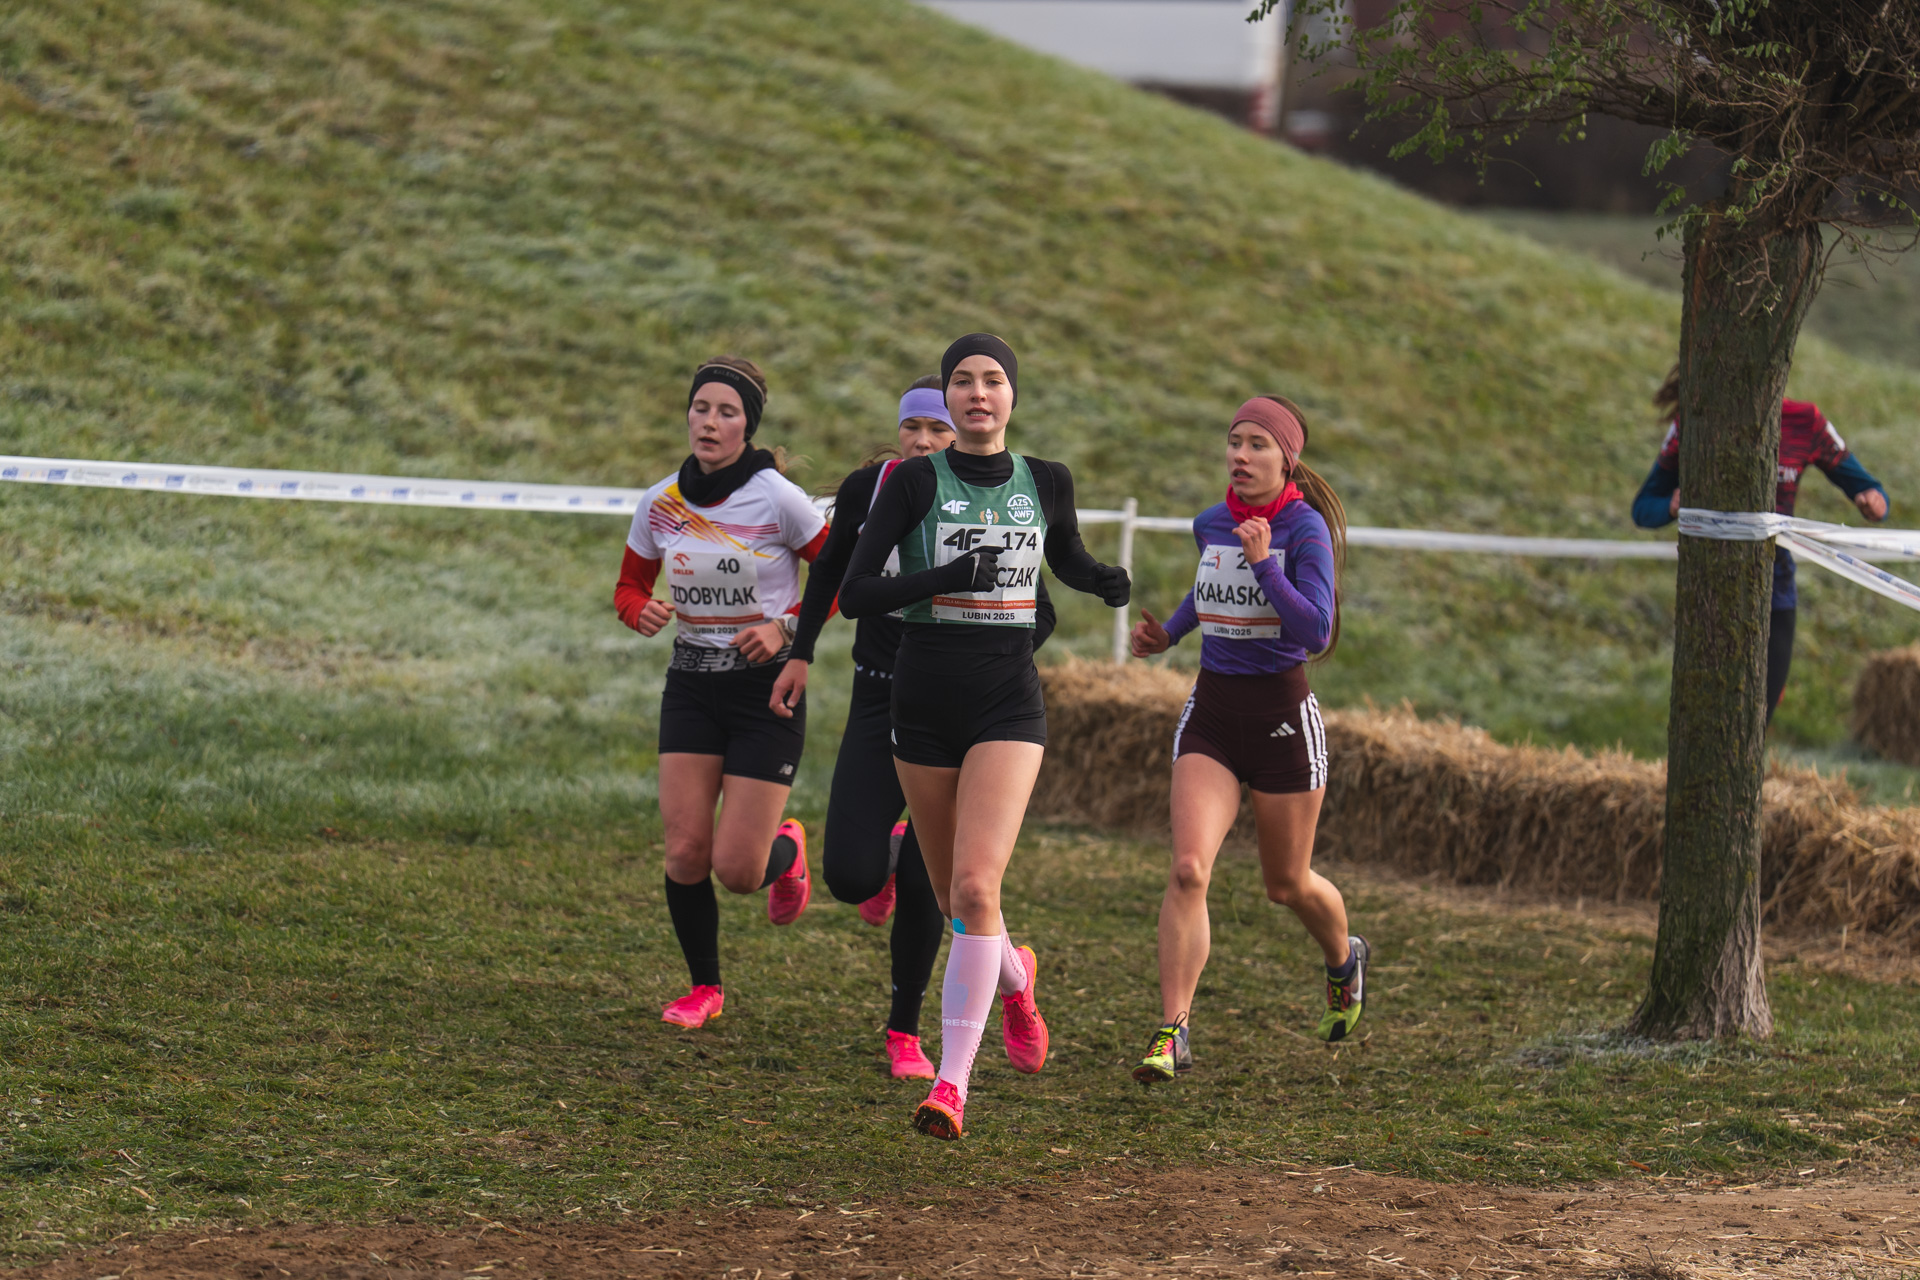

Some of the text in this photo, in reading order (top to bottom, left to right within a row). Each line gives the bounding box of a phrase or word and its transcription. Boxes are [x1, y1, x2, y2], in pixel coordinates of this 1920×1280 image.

[941, 499, 970, 514] 4F
[1014, 510, 1031, 518] AWF
[943, 528, 987, 550] 4F
[1002, 531, 1037, 551] 174
[716, 557, 740, 574] 40
[995, 567, 1036, 588] CZAK
[670, 584, 757, 606] ZDOBYLAK
[1196, 581, 1269, 606] KAŁASK
[962, 611, 1015, 620] LUBIN 2025
[692, 626, 738, 634] LUBIN 2025
[1214, 626, 1252, 636] LUBIN 2025
